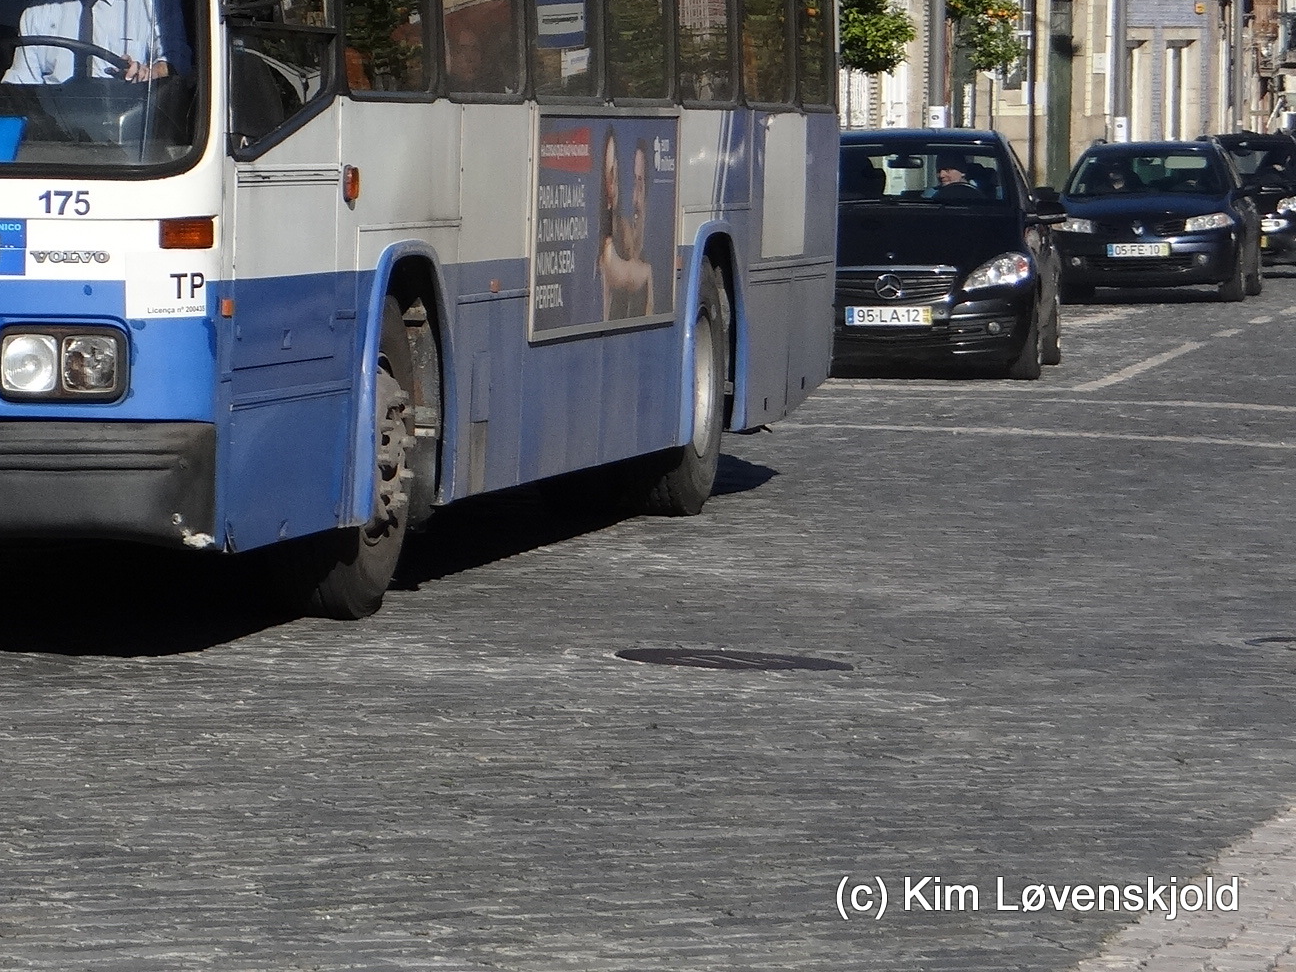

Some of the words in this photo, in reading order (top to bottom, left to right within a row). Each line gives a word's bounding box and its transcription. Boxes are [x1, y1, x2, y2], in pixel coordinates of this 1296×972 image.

[39, 190, 91, 216] 175
[538, 184, 554, 209] PARA
[30, 250, 111, 263] VOLVO
[536, 250, 558, 276] NUNCA
[558, 243, 575, 274] SERÁ
[169, 272, 205, 299] TP
[147, 306, 176, 315] Licença
